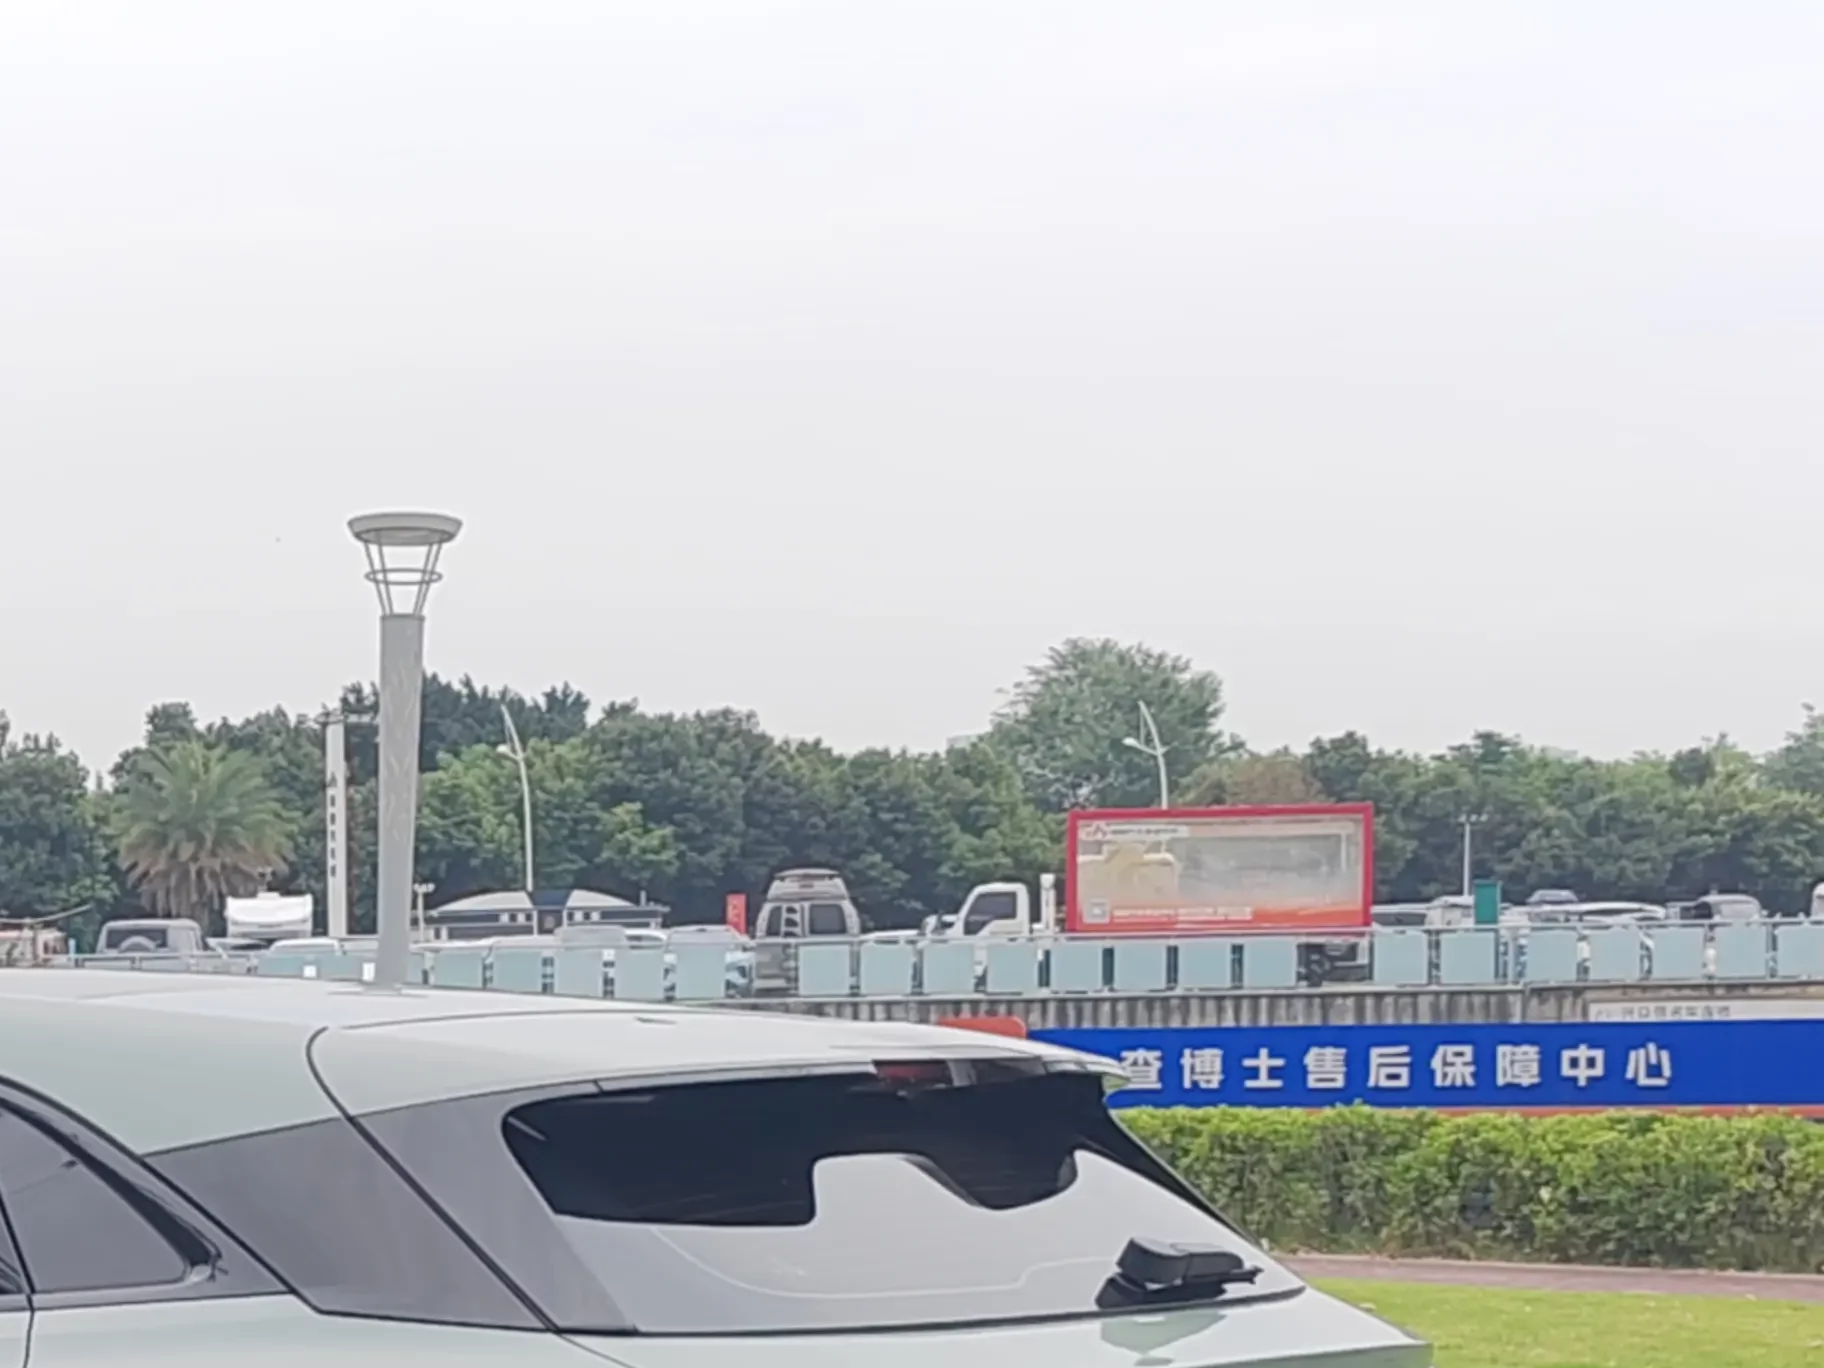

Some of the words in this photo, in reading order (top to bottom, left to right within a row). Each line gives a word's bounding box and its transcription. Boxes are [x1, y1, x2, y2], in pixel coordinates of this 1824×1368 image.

[1119, 1042, 1673, 1091] 查博士售后保障中心
